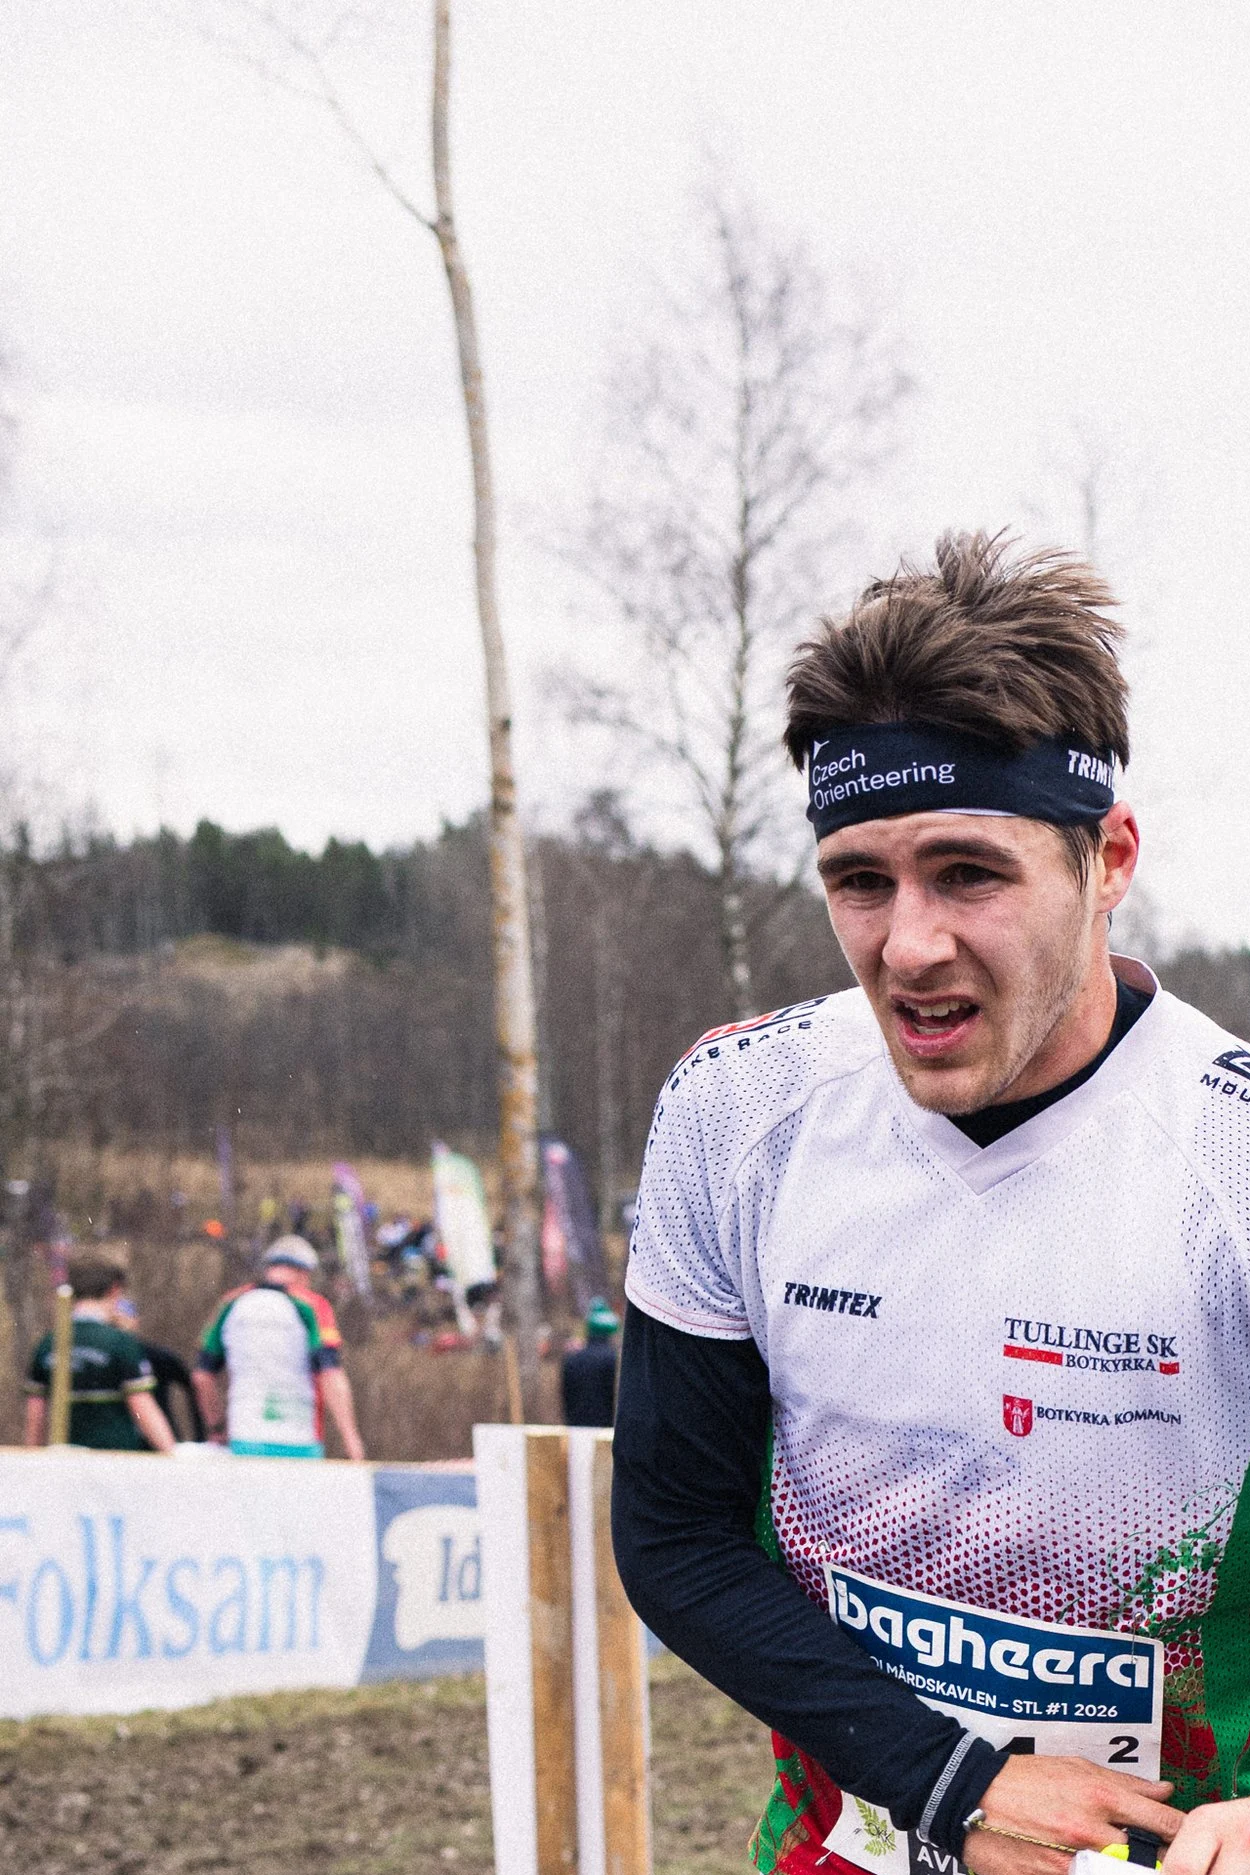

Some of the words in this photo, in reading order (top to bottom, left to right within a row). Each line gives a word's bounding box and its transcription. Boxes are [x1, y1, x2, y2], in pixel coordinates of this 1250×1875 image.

[811, 749, 865, 786] Czech
[814, 763, 955, 810] Orienteering
[784, 1281, 882, 1319] TRIMTEX
[1004, 1317, 1141, 1354] TULLINGE
[1147, 1334, 1179, 1358] SK
[1065, 1353, 1157, 1374] BOTKYRKA
[1036, 1406, 1110, 1426] BOTKYRKA
[1114, 1408, 1182, 1425] KOMMUN
[834, 1578, 1150, 1688] bagheera
[886, 1661, 997, 1709] MÅRDSKAVLEN
[1012, 1699, 1042, 1715] STL
[1046, 1702, 1068, 1716] #1
[1074, 1703, 1118, 1718] 2026
[1108, 1735, 1140, 1763] 2
